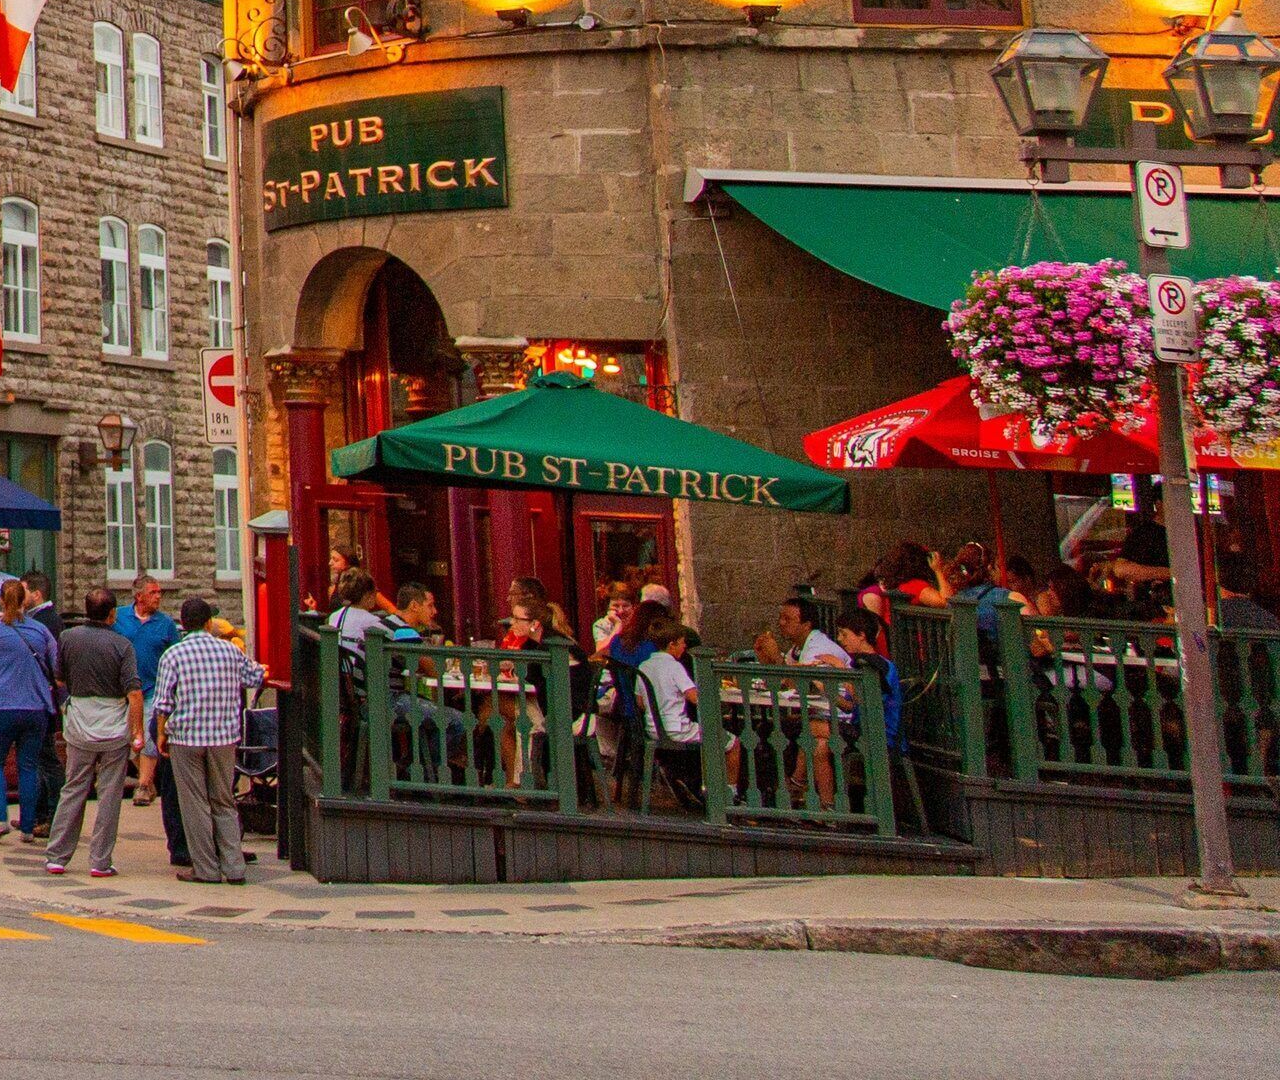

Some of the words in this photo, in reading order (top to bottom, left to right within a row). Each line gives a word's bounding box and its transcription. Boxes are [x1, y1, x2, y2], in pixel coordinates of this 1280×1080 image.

[309, 115, 385, 152] PUB
[263, 157, 500, 213] ST-PATRICK
[441, 443, 527, 479] PUB
[540, 455, 781, 506] ST-PATRICK
